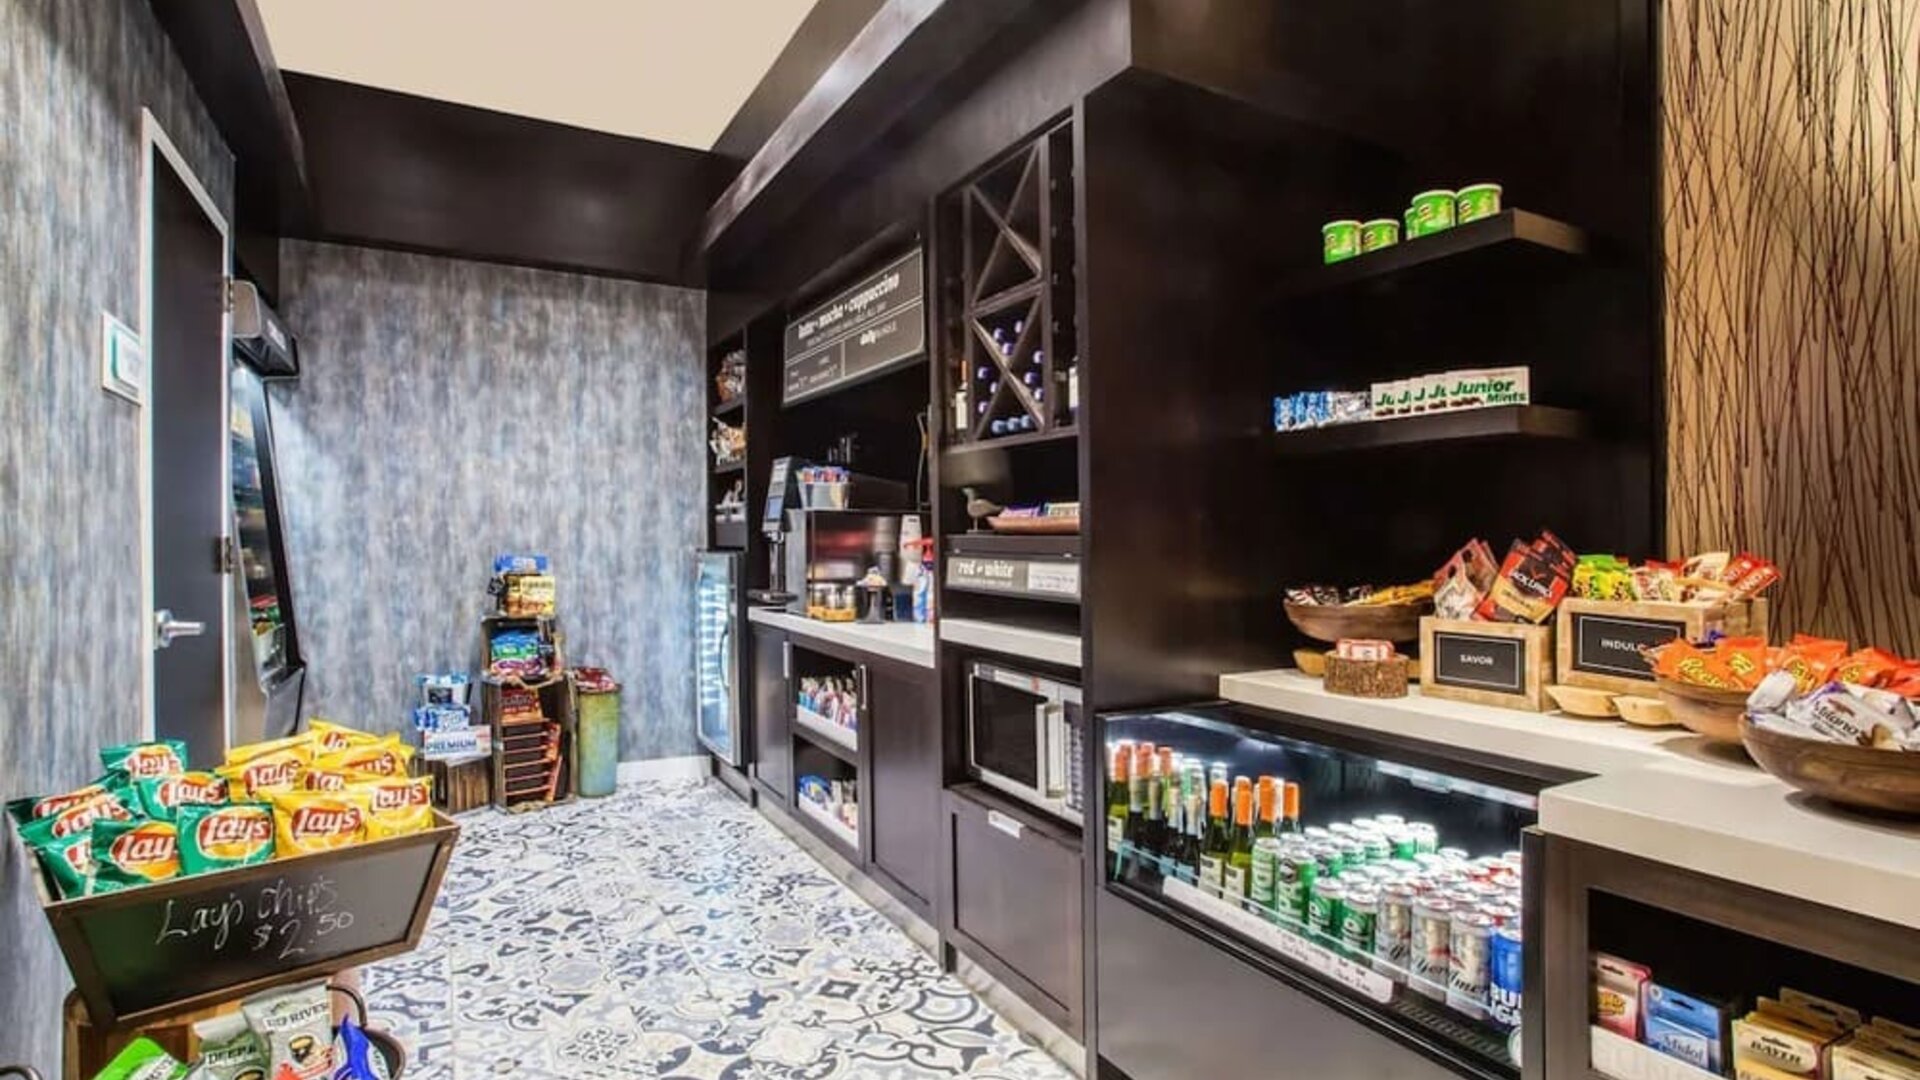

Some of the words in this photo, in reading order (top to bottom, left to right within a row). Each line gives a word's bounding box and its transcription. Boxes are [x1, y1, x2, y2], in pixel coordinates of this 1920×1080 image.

[1450, 379, 1515, 397] Junior
[1486, 391, 1526, 404] Mints
[1459, 653, 1494, 666] SAVOR
[426, 739, 477, 754] PREMIUM
[1750, 1040, 1802, 1066] BAYER
